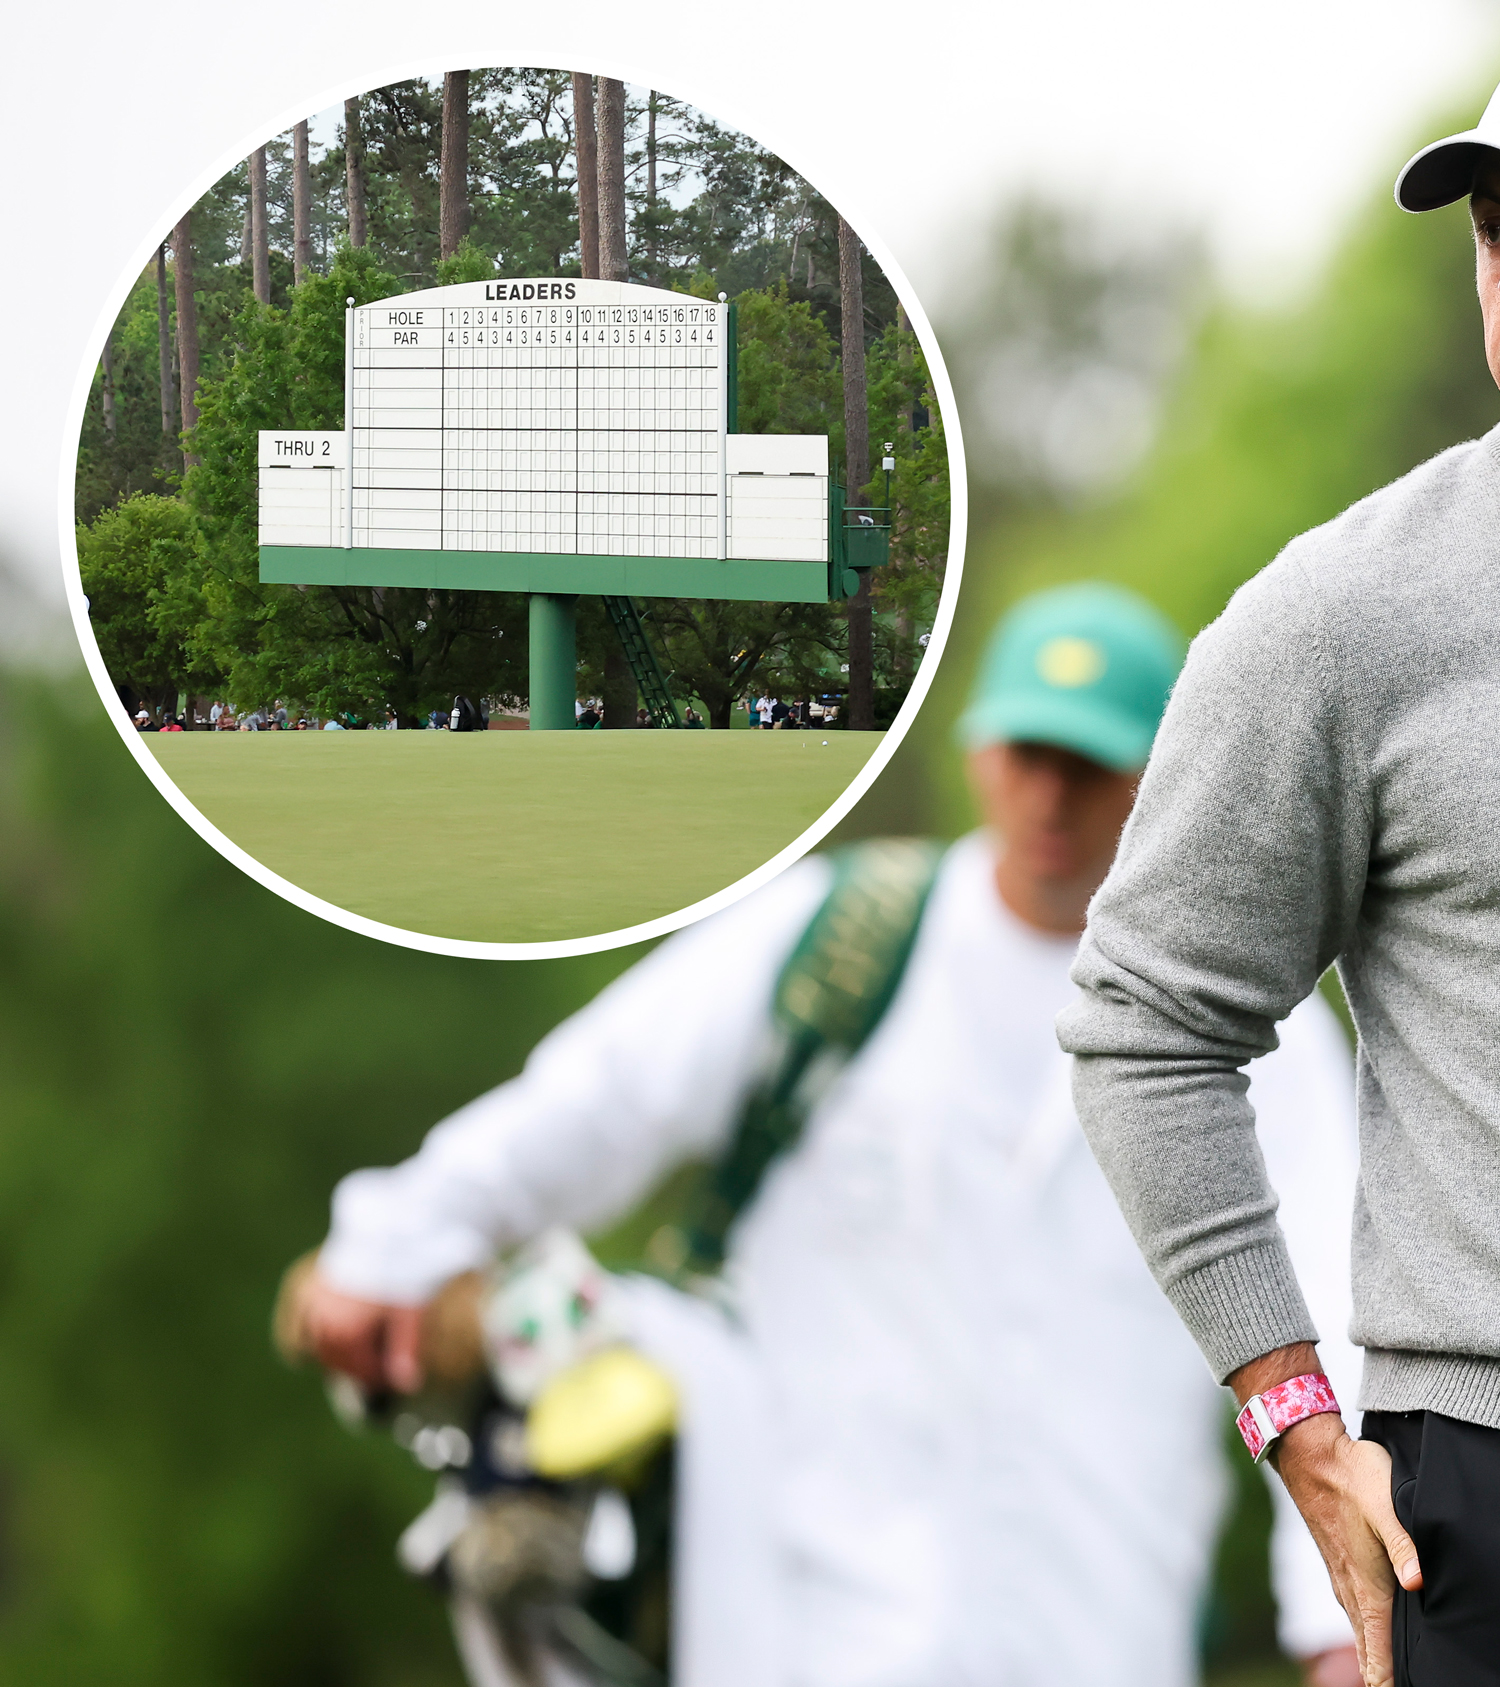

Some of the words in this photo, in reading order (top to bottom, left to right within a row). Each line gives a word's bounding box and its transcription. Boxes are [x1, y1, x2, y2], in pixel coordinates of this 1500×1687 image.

[485, 282, 577, 301] LEADERS
[388, 311, 424, 326] HOLE
[449, 311, 454, 324] 1
[463, 310, 469, 325] 2
[477, 310, 484, 325] 3
[491, 311, 498, 324] 4
[506, 310, 513, 325] 5
[520, 309, 528, 324] 6
[536, 310, 542, 324] 7
[550, 309, 557, 324] 8
[565, 309, 573, 324] 9
[580, 309, 592, 324] 10
[597, 309, 606, 323] 11
[611, 308, 622, 323] 12
[627, 308, 638, 323] 13
[642, 309, 654, 322] 14
[657, 308, 669, 323] 15
[673, 308, 685, 323] 16
[689, 308, 700, 322] 17
[704, 307, 716, 323] 18
[393, 331, 419, 345] PAR
[447, 331, 455, 344] 4
[462, 331, 469, 345] 5
[477, 331, 484, 344] 4
[492, 330, 499, 345] 3
[506, 330, 513, 344] 4
[521, 330, 528, 345] 3
[535, 330, 542, 344] 4
[550, 330, 557, 344] 5
[565, 330, 572, 344] 4
[582, 329, 589, 343] 4
[597, 329, 605, 343] 4
[613, 329, 620, 344] 3
[628, 329, 635, 344] 5
[644, 329, 651, 343] 4
[659, 329, 666, 344] 5
[674, 329, 682, 344] 3
[690, 329, 698, 343] 4
[706, 329, 714, 343] 4
[274, 440, 314, 457] THRU
[321, 440, 331, 456] 2
